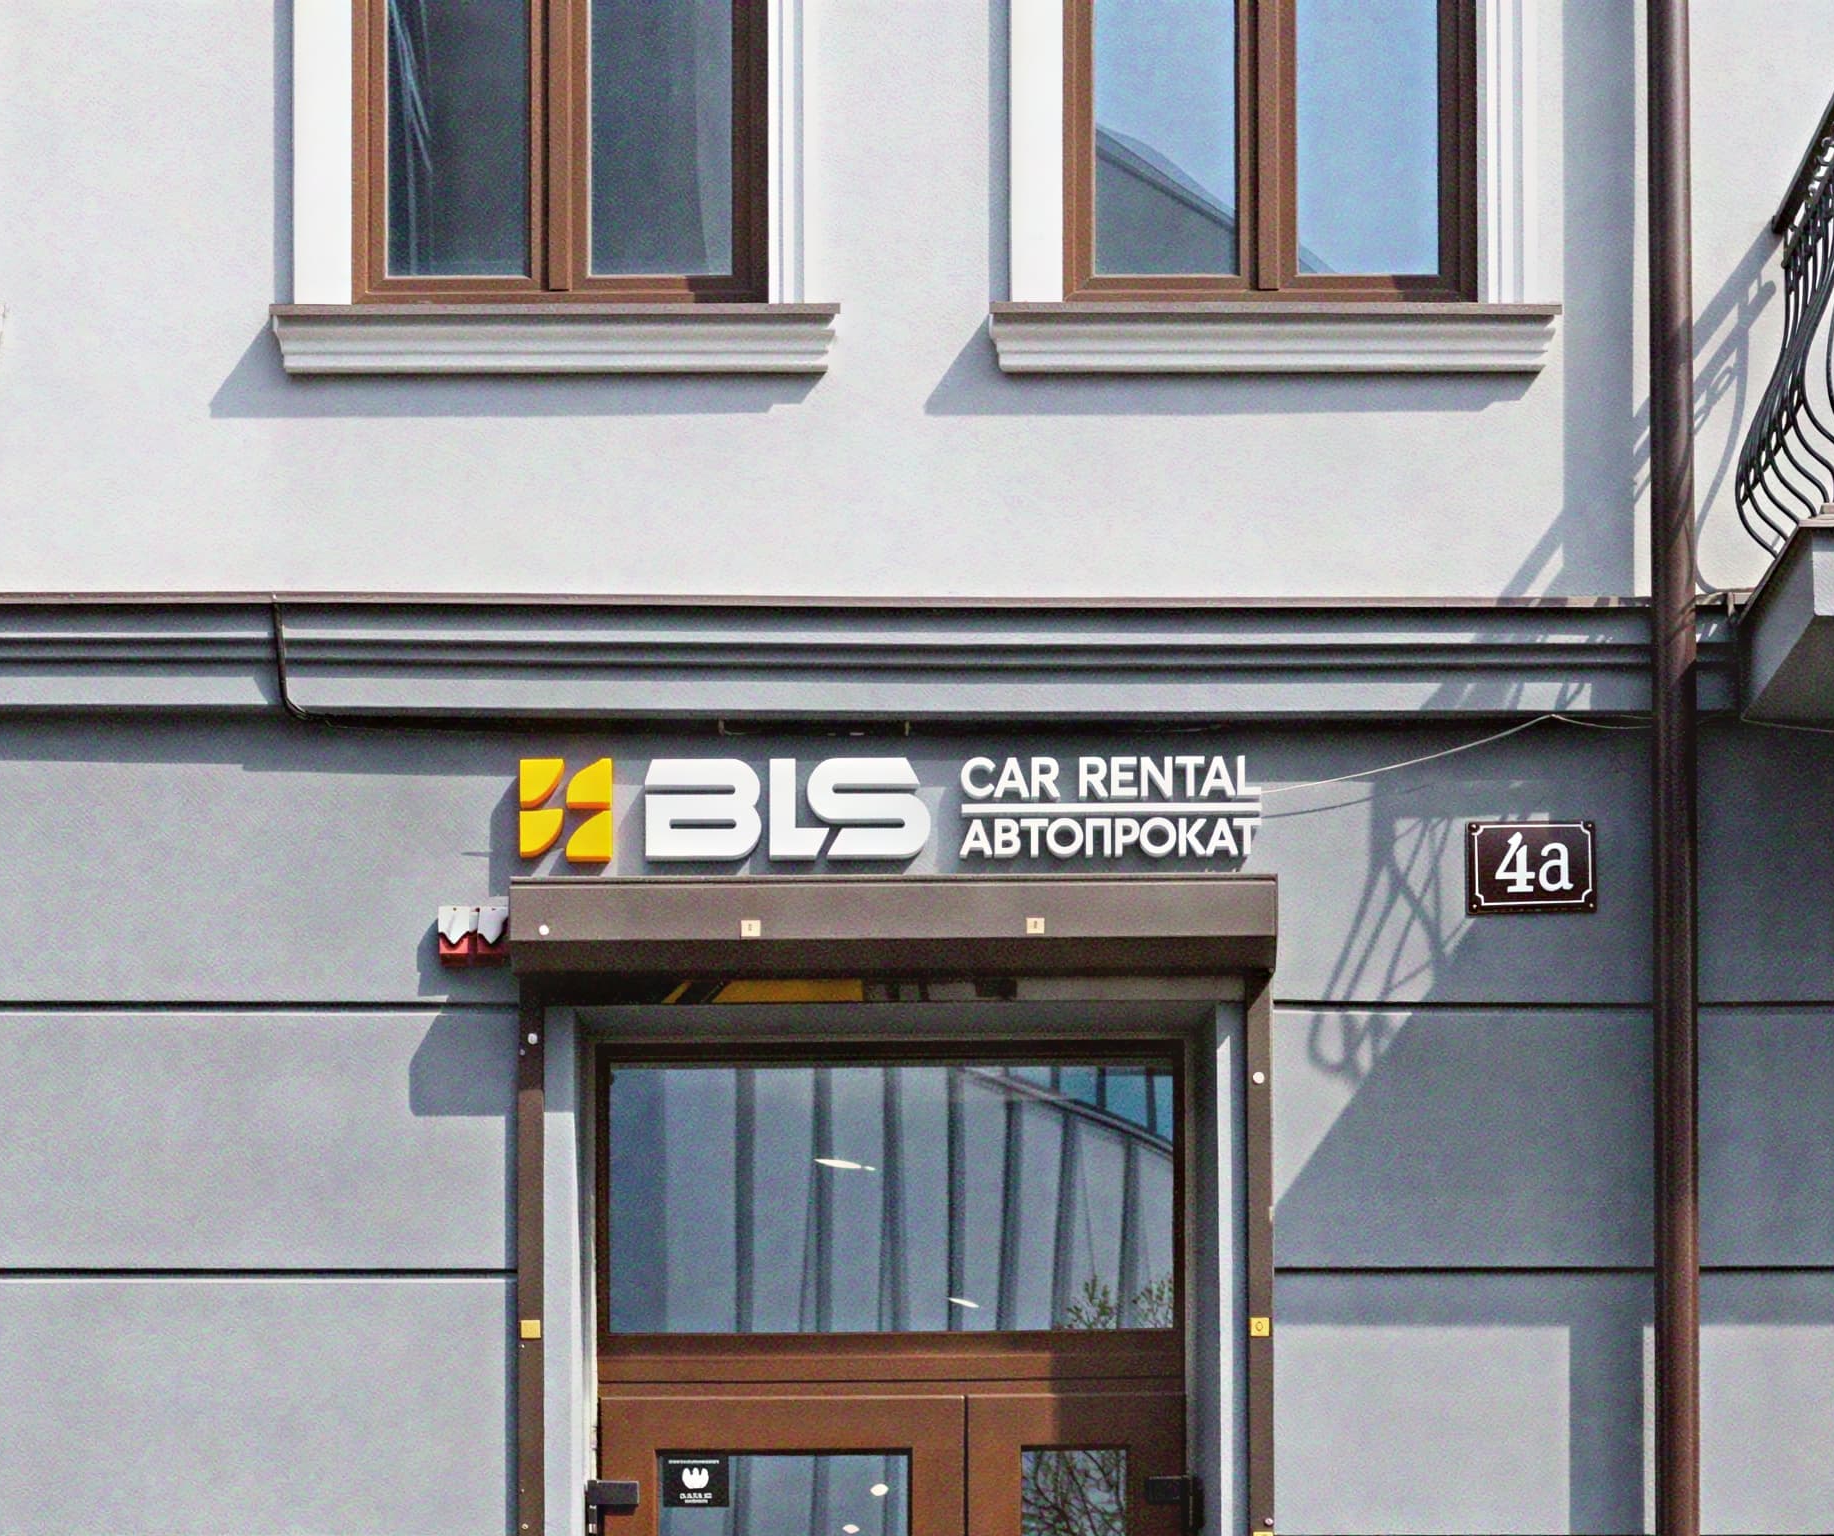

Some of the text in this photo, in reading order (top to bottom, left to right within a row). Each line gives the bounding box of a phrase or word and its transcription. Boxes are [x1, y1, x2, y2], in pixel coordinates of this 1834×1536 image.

[960, 755, 1262, 800] CAR RENTAL
[645, 757, 931, 861] BLS
[959, 817, 1262, 859] АВТОПРОКАТ
